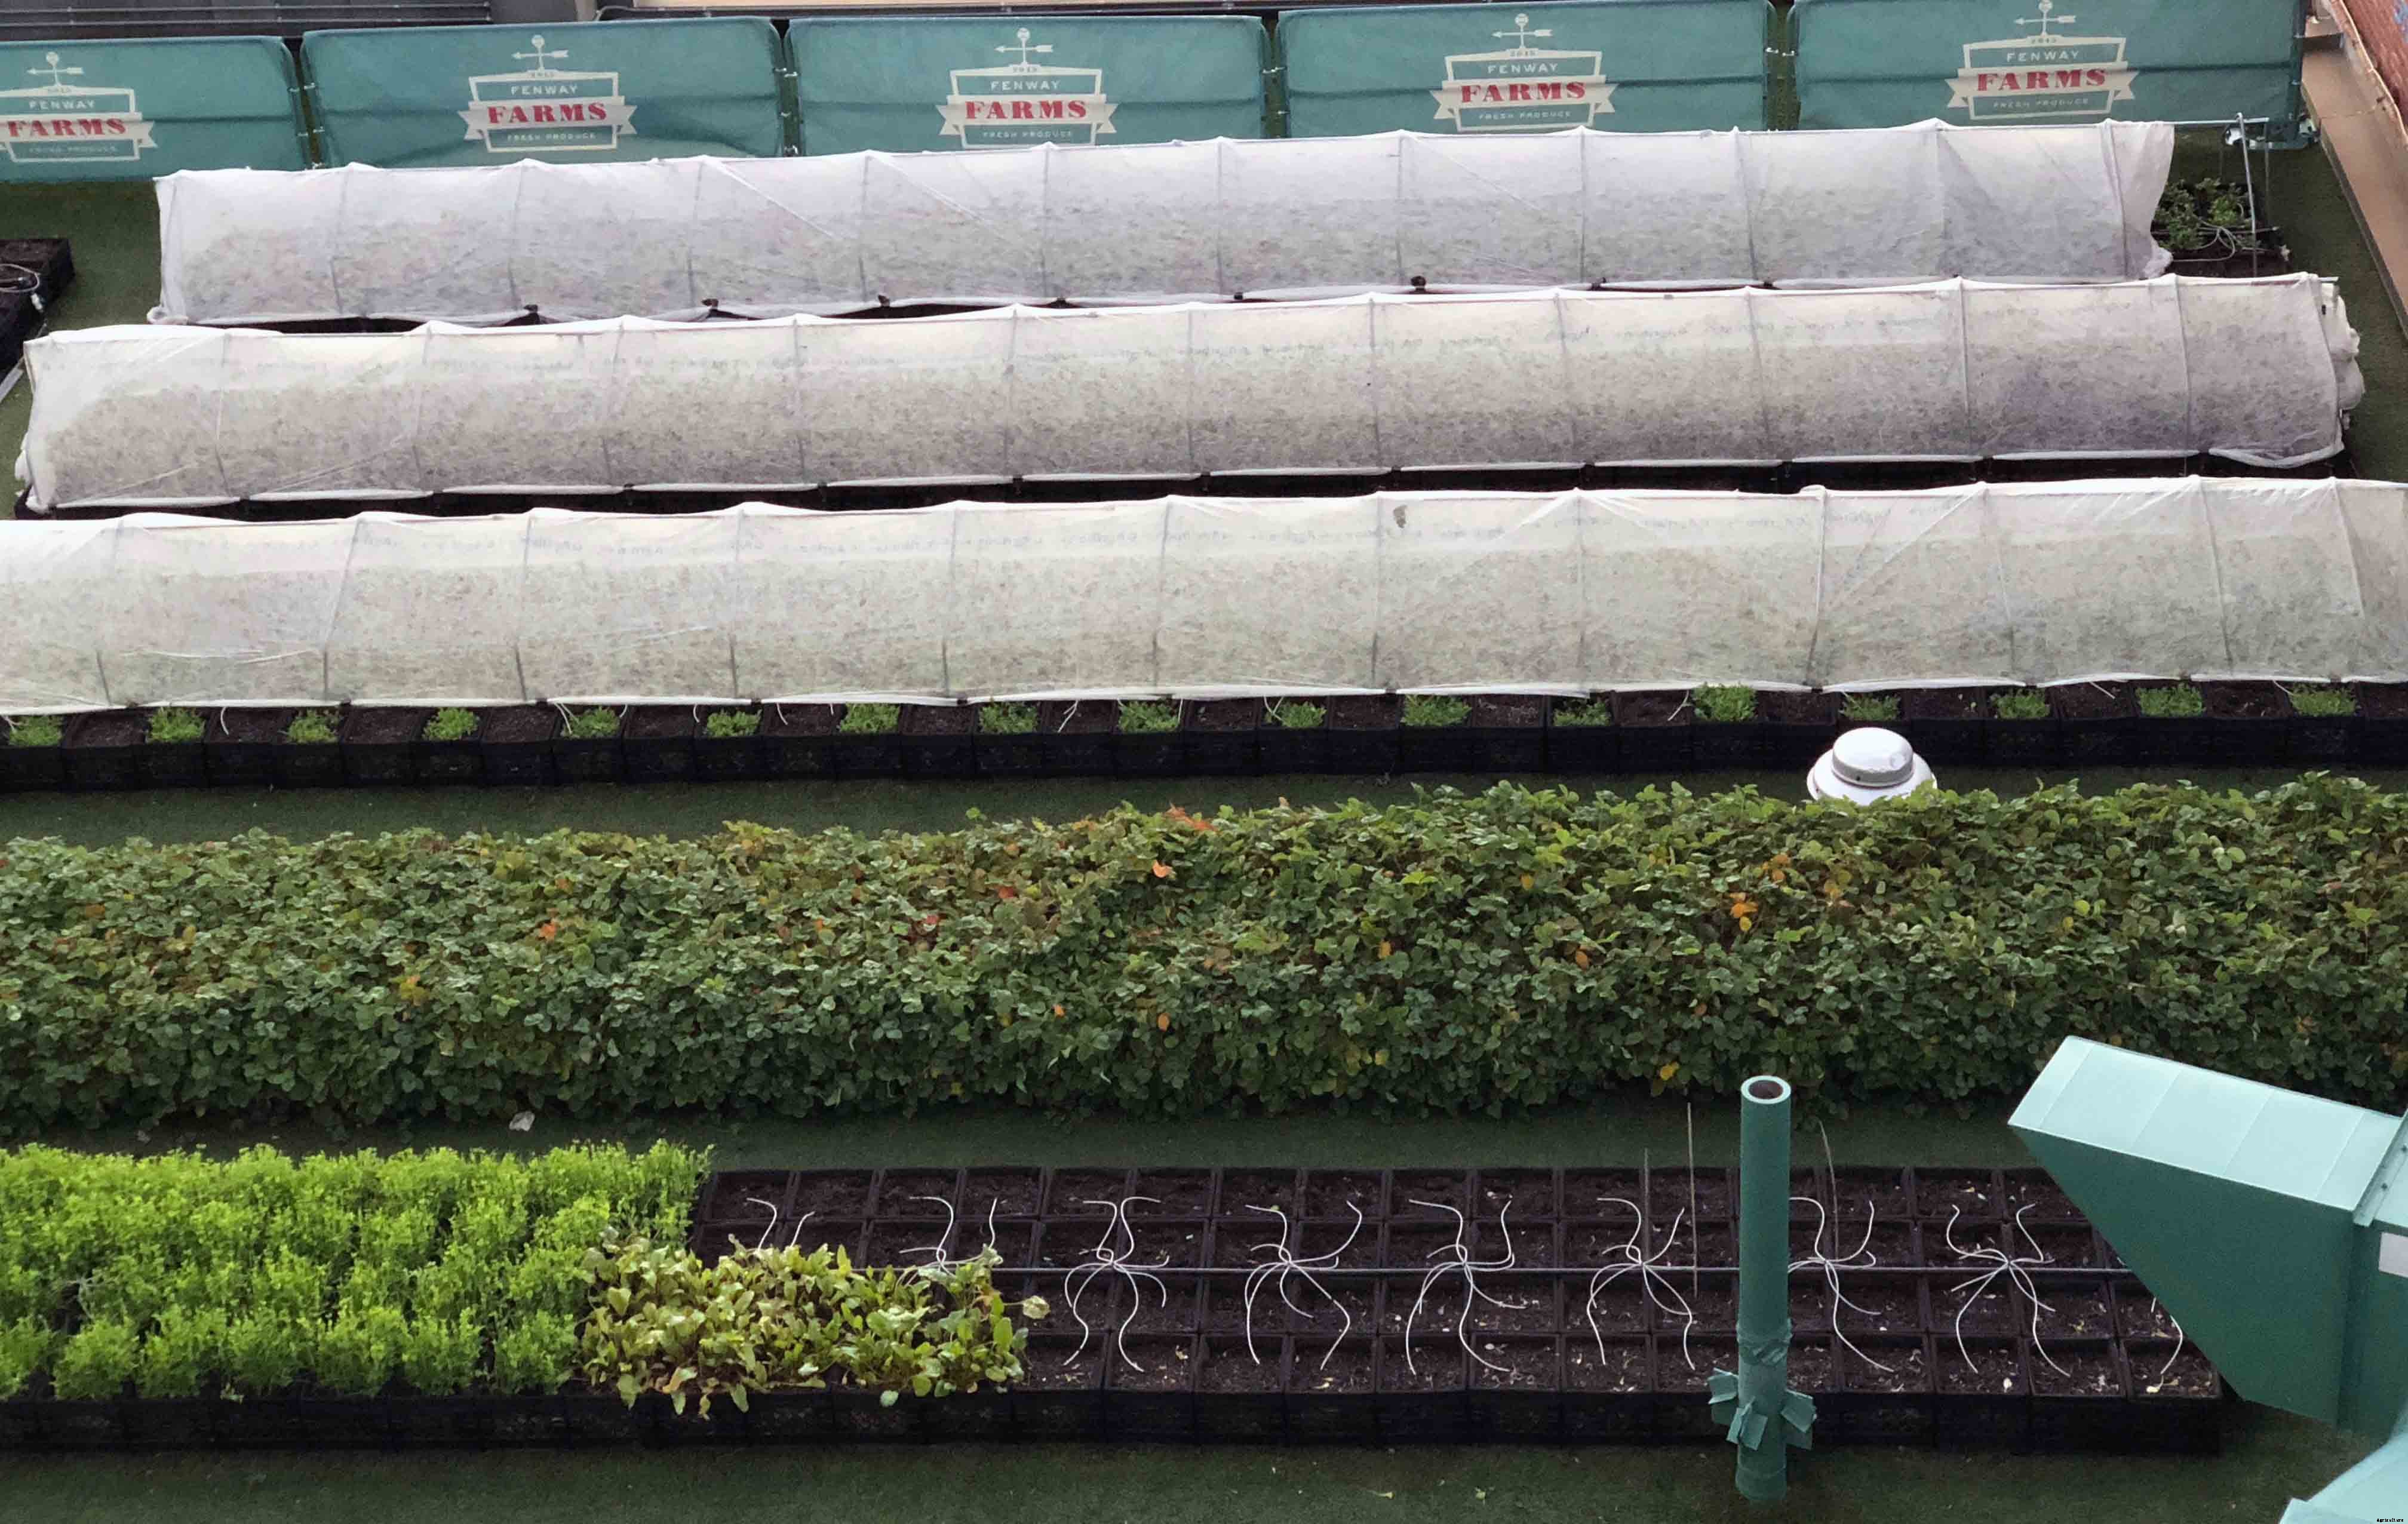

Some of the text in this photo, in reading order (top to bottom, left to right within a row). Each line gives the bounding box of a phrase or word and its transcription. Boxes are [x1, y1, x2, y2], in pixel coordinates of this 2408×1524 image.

[2007, 50, 2080, 63] FENWAY
[1487, 62, 1559, 74] FENWAY
[990, 80, 1061, 91] FENWAY
[1976, 68, 2108, 91] FARMS
[511, 84, 578, 96] FENWAY
[1460, 81, 1586, 103] FARMS
[29, 100, 96, 110] FENWAY
[487, 102, 608, 124] FARMS
[965, 100, 1087, 119] FARMS
[7, 118, 127, 137] FARMS
